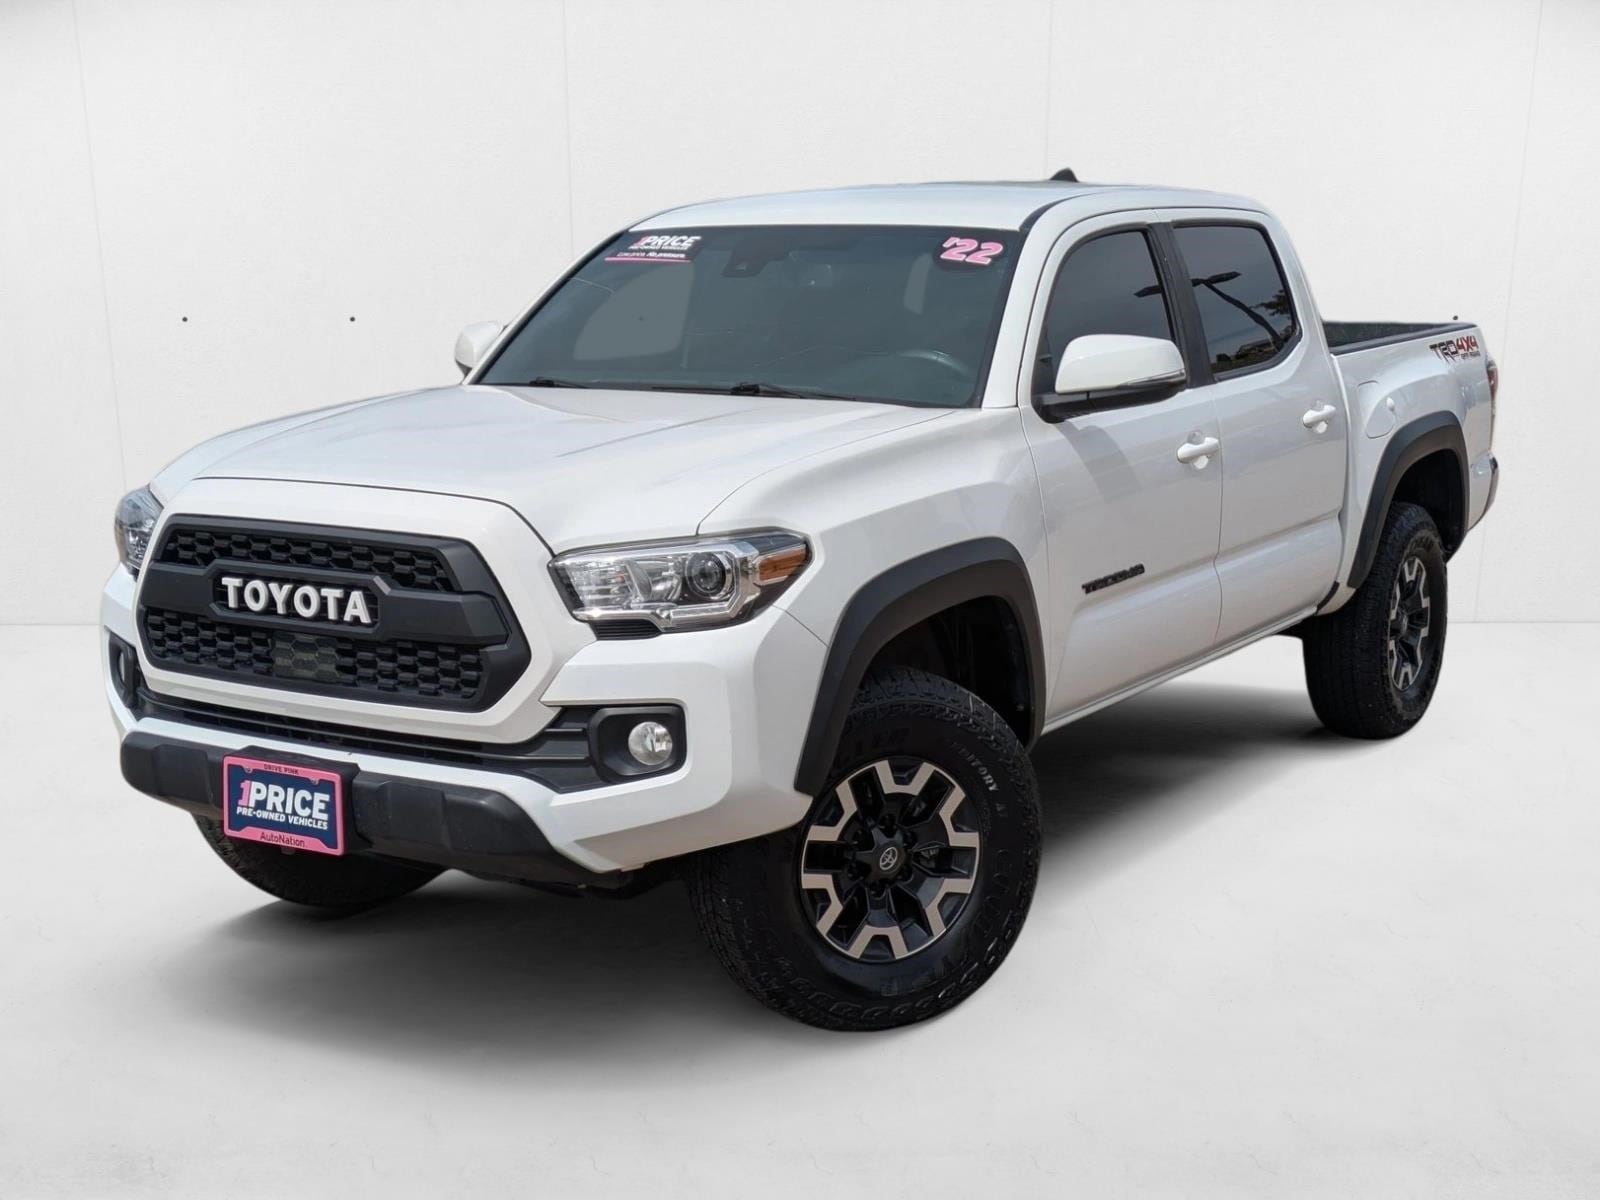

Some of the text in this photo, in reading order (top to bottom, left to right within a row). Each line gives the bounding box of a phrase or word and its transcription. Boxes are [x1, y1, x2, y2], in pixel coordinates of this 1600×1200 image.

[940, 236, 1004, 265] '22
[221, 576, 372, 624] TOYOTA
[263, 763, 299, 775] DRIVE PINK
[238, 780, 330, 821] 1PRICE
[236, 806, 328, 831] PRE-OWNED VEHICLES
[260, 831, 305, 848] AutoNation
